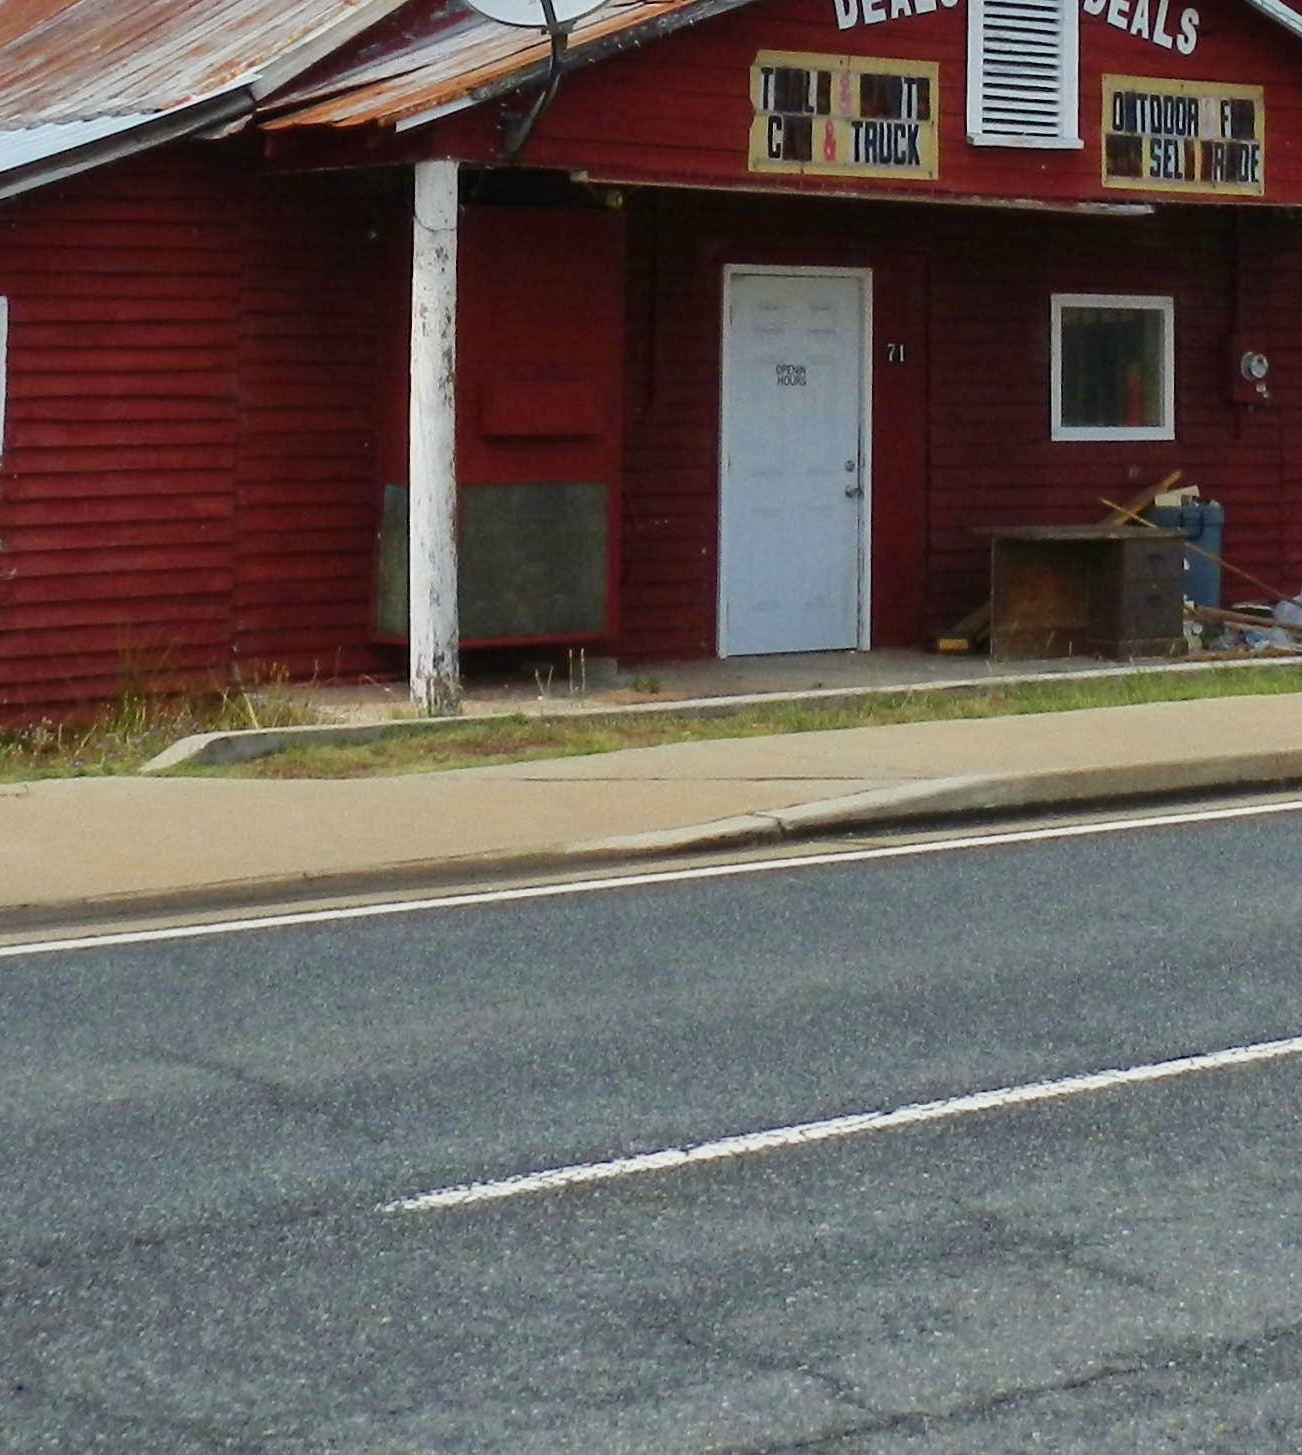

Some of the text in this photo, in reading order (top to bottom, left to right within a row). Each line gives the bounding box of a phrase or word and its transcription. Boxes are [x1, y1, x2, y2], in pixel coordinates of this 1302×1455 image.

[823, 118, 836, 163] &
[851, 120, 921, 166] TRUCK
[887, 343, 905, 362] 71
